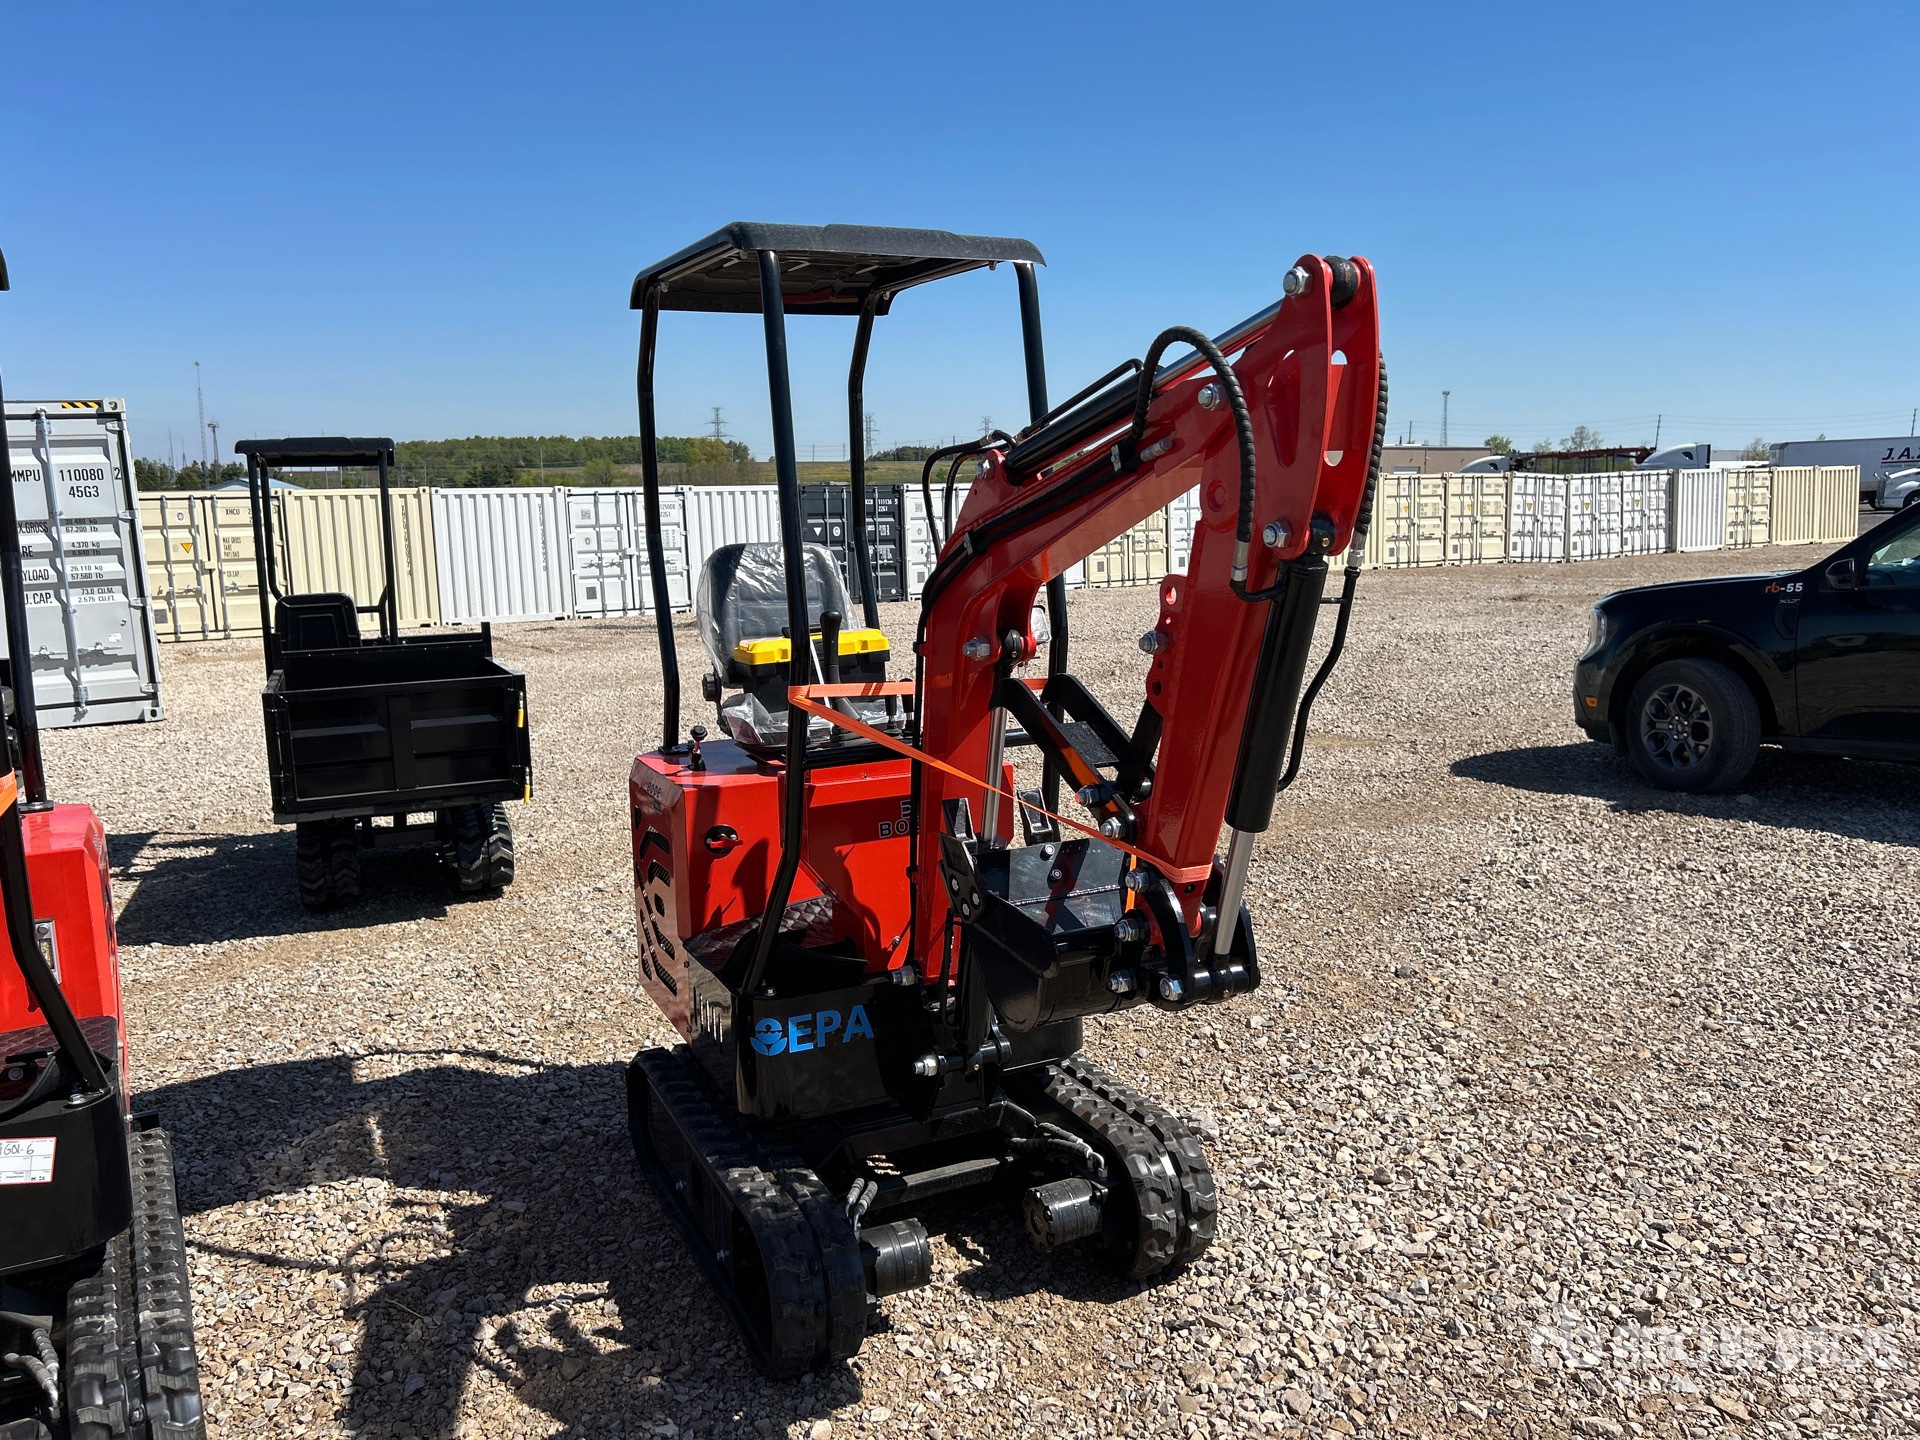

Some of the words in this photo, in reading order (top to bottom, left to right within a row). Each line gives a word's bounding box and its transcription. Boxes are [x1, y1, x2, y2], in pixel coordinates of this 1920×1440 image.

[59, 468, 104, 482] 110080
[113, 467, 122, 480] 2
[68, 485, 100, 498] 45G3
[17, 521, 49, 534] X.GROSS
[71, 541, 89, 549] 4.370
[22, 568, 50, 581] YLOAD
[788, 1004, 875, 1054] EPA
